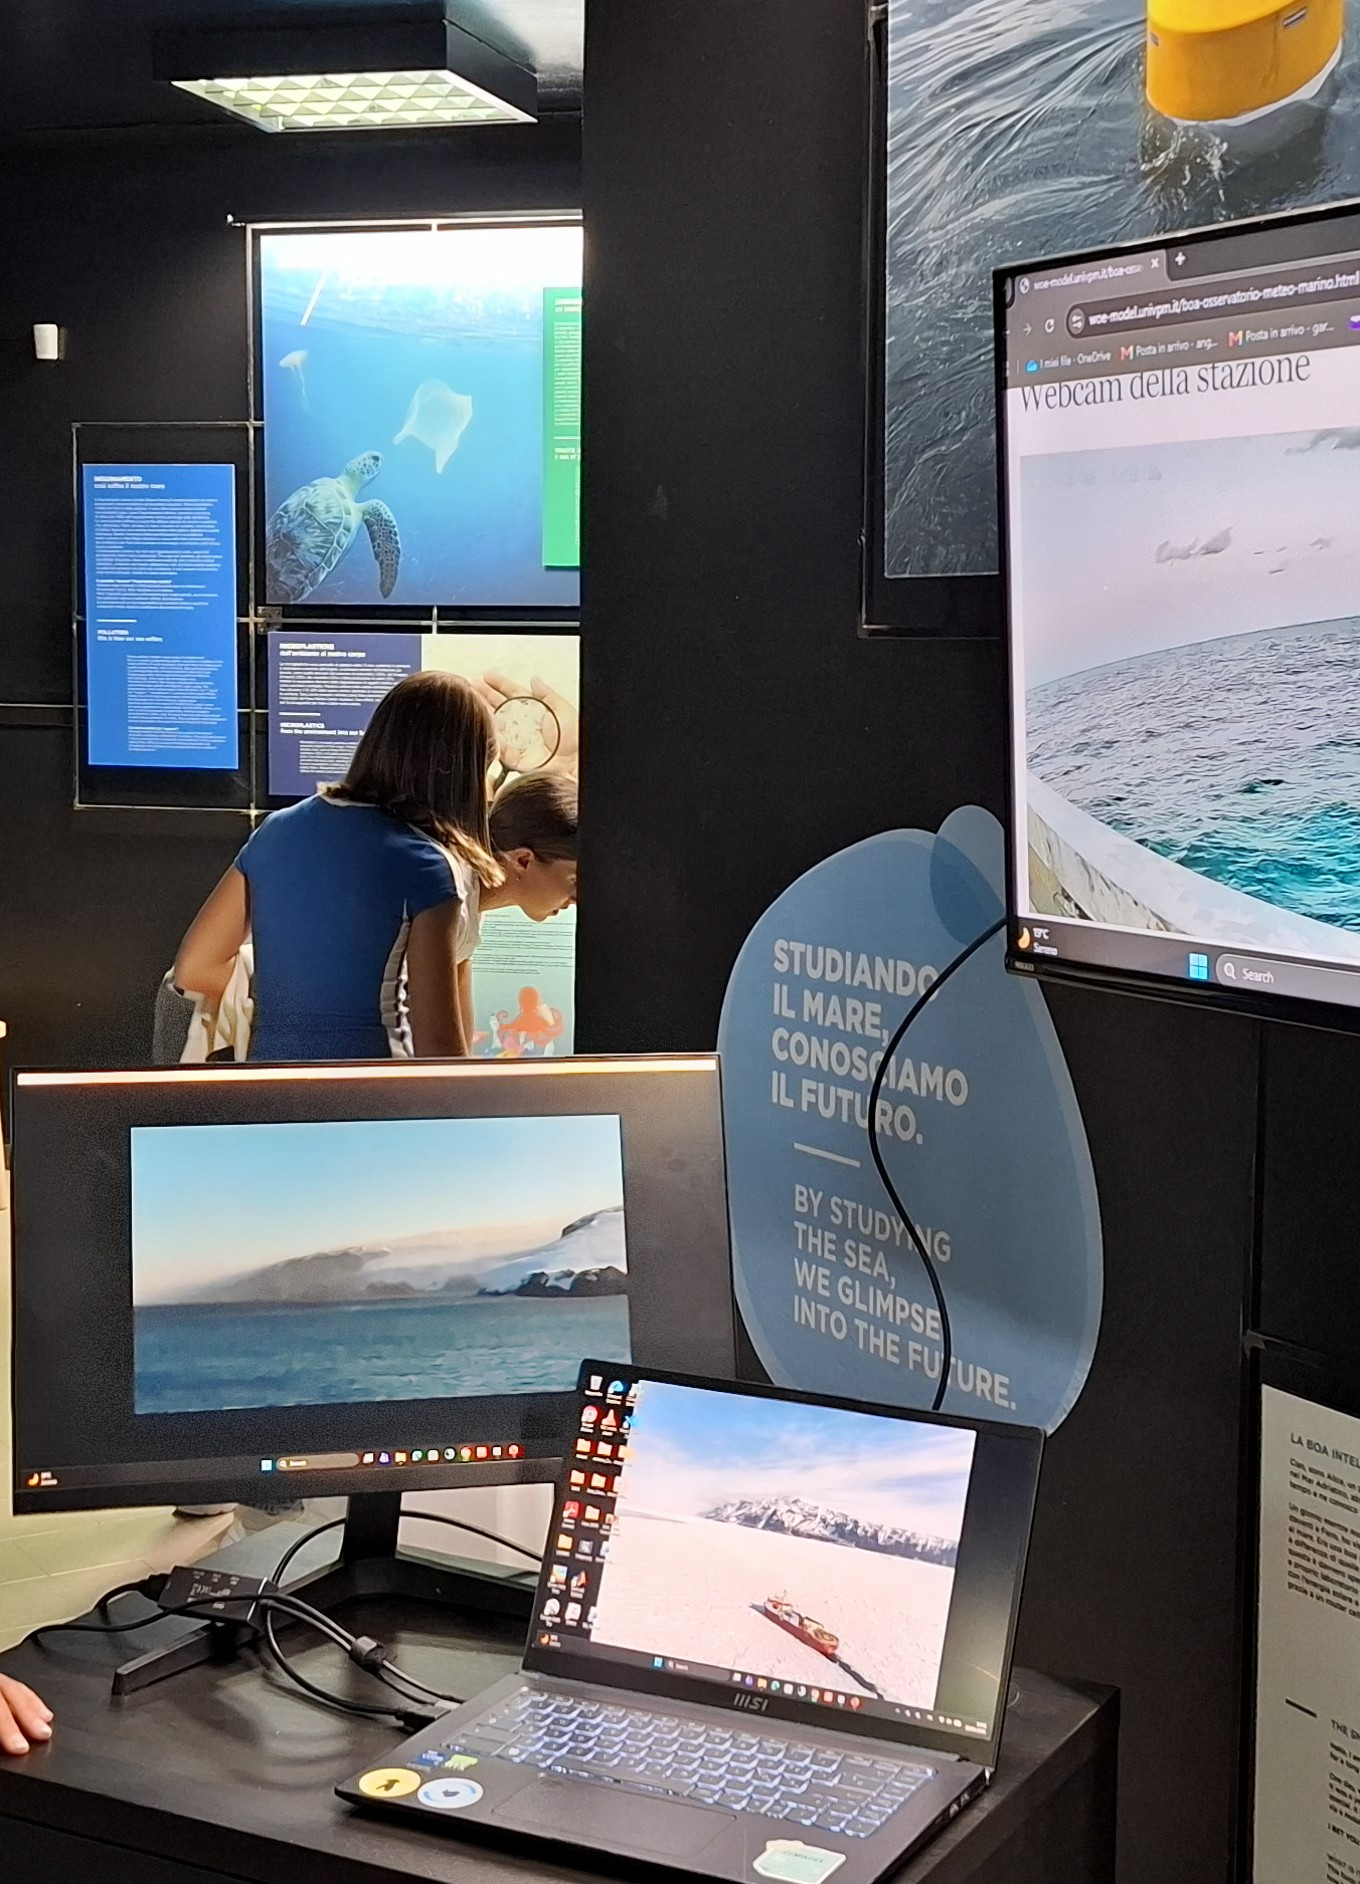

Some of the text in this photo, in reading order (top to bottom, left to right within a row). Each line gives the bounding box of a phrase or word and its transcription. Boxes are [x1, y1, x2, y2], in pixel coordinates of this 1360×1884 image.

[1245, 324, 1304, 342] Posta in arrivo
[1077, 351, 1111, 364] OneDrive
[1022, 354, 1311, 412] Webcam della stazione
[1242, 968, 1274, 984] Search
[773, 983, 889, 1047] IL MARE,
[771, 1070, 794, 1110] IL
[795, 1184, 824, 1219] BY
[795, 1221, 897, 1291] THE SEA,
[793, 1257, 940, 1341] WE GLIMPSE
[793, 1295, 847, 1341] INTO
[854, 1318, 900, 1365] THE
[1290, 1433, 1304, 1447] LA
[1307, 1439, 1329, 1456] BOA
[1332, 1720, 1348, 1737] THE
